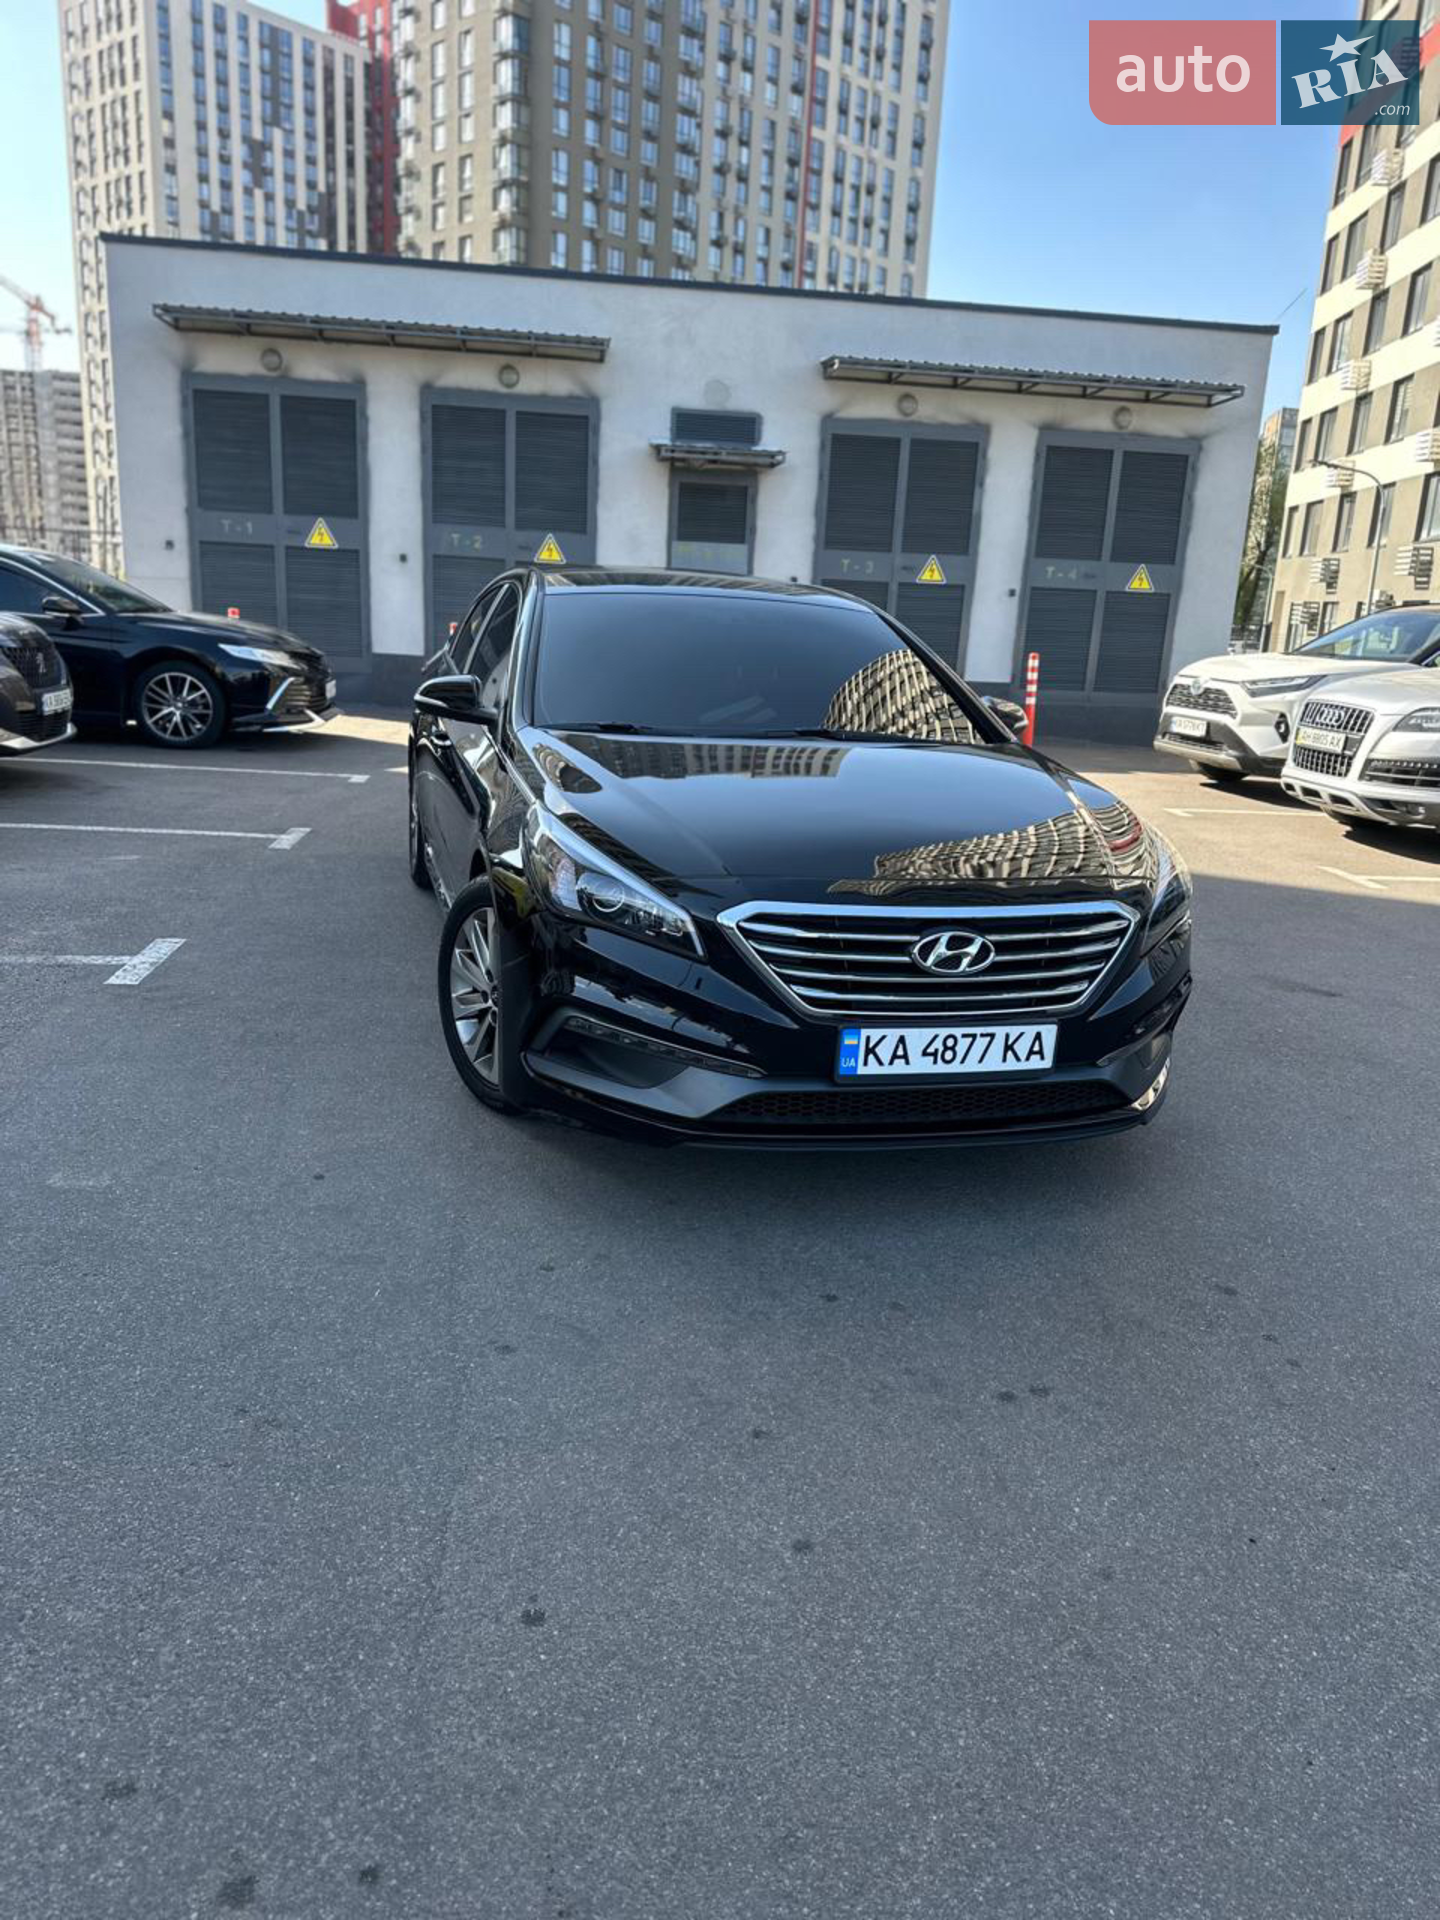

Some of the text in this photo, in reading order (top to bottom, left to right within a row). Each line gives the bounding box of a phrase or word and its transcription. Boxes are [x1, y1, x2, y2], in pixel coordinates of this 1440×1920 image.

[841, 1031, 1046, 1068] UA KA 4877 KA
